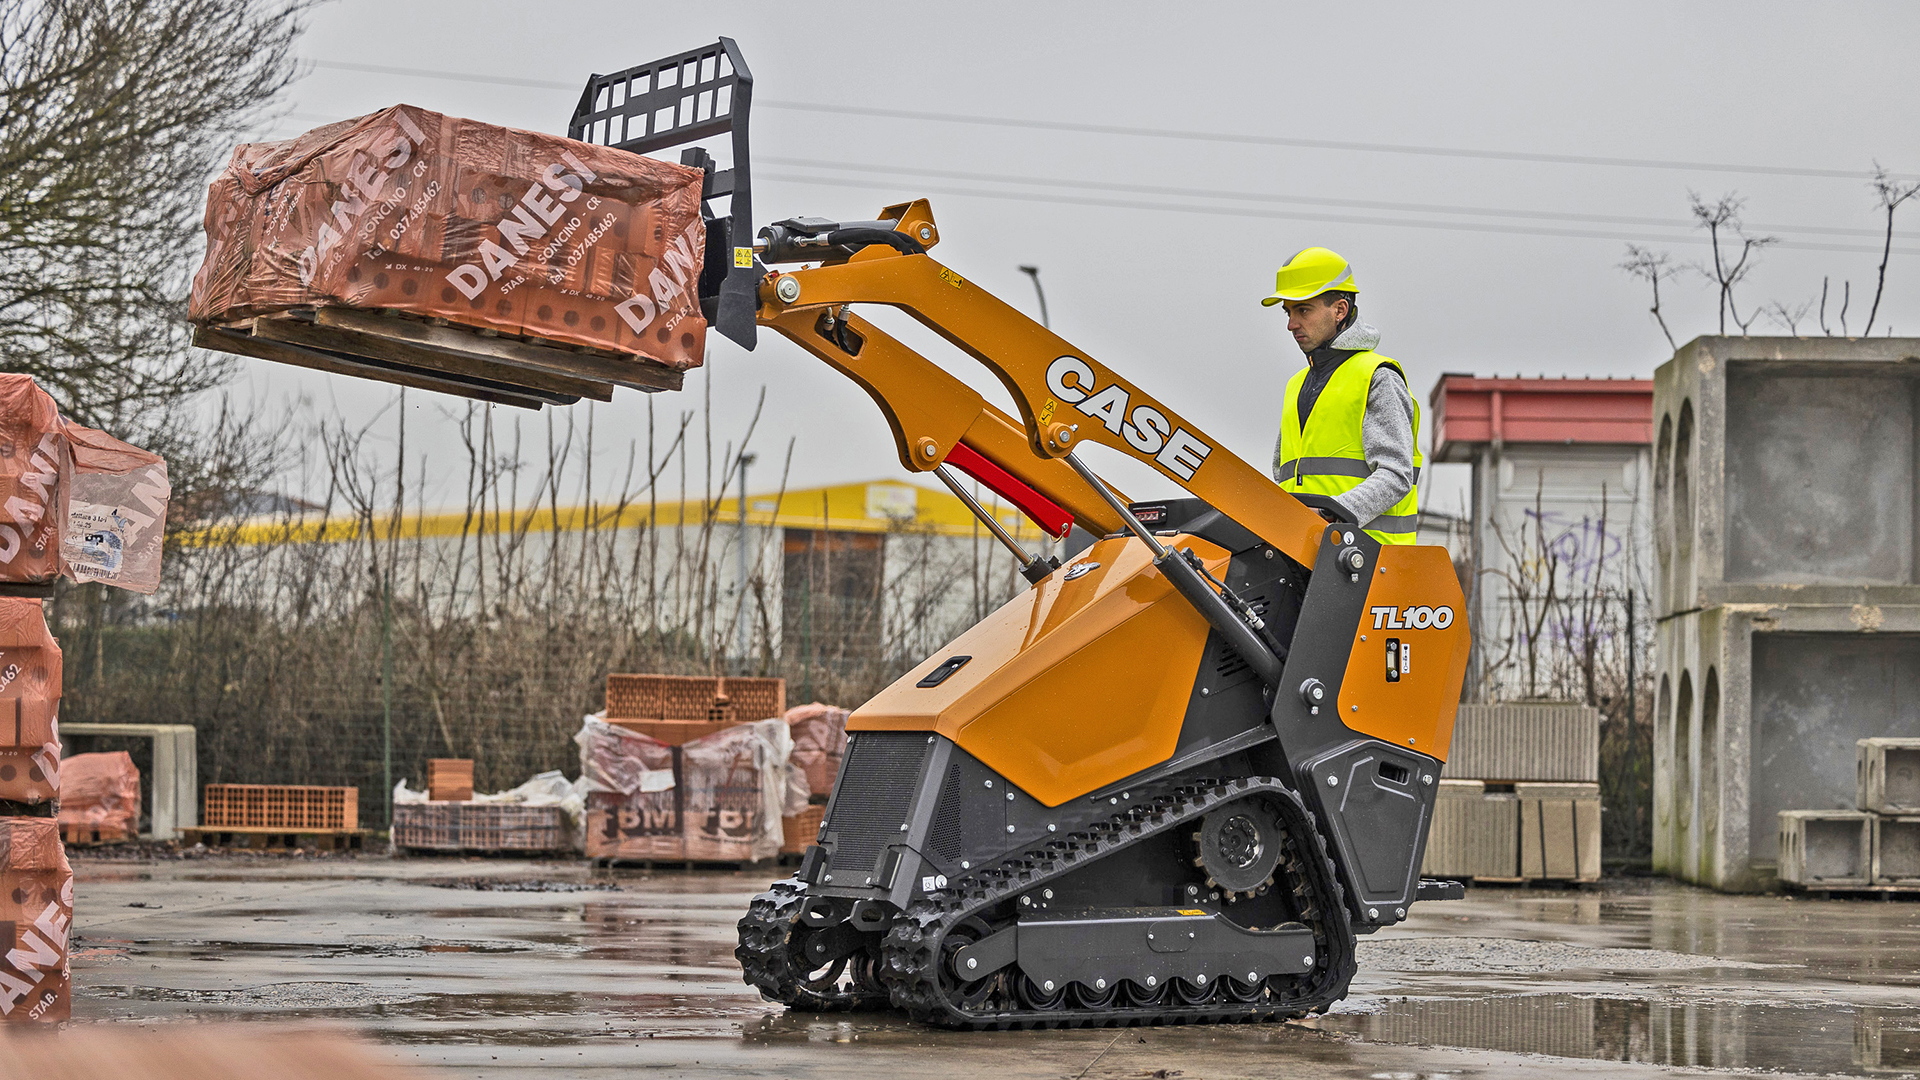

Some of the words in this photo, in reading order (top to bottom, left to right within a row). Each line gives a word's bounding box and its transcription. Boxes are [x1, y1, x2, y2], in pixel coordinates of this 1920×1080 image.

[299, 108, 426, 286] DANESI
[357, 186, 407, 240] SONCINO
[413, 160, 429, 178] CR
[362, 242, 390, 261] Tel.
[389, 180, 442, 240] 037485462
[445, 150, 597, 300] DANESI
[537, 217, 582, 265] SONCINO
[586, 196, 602, 211] CR
[395, 263, 407, 271] DX
[567, 212, 617, 267] 037485462
[1045, 354, 1214, 483] CASE
[1369, 605, 1455, 630] TL100
[28, 992, 59, 1020] STAB.
